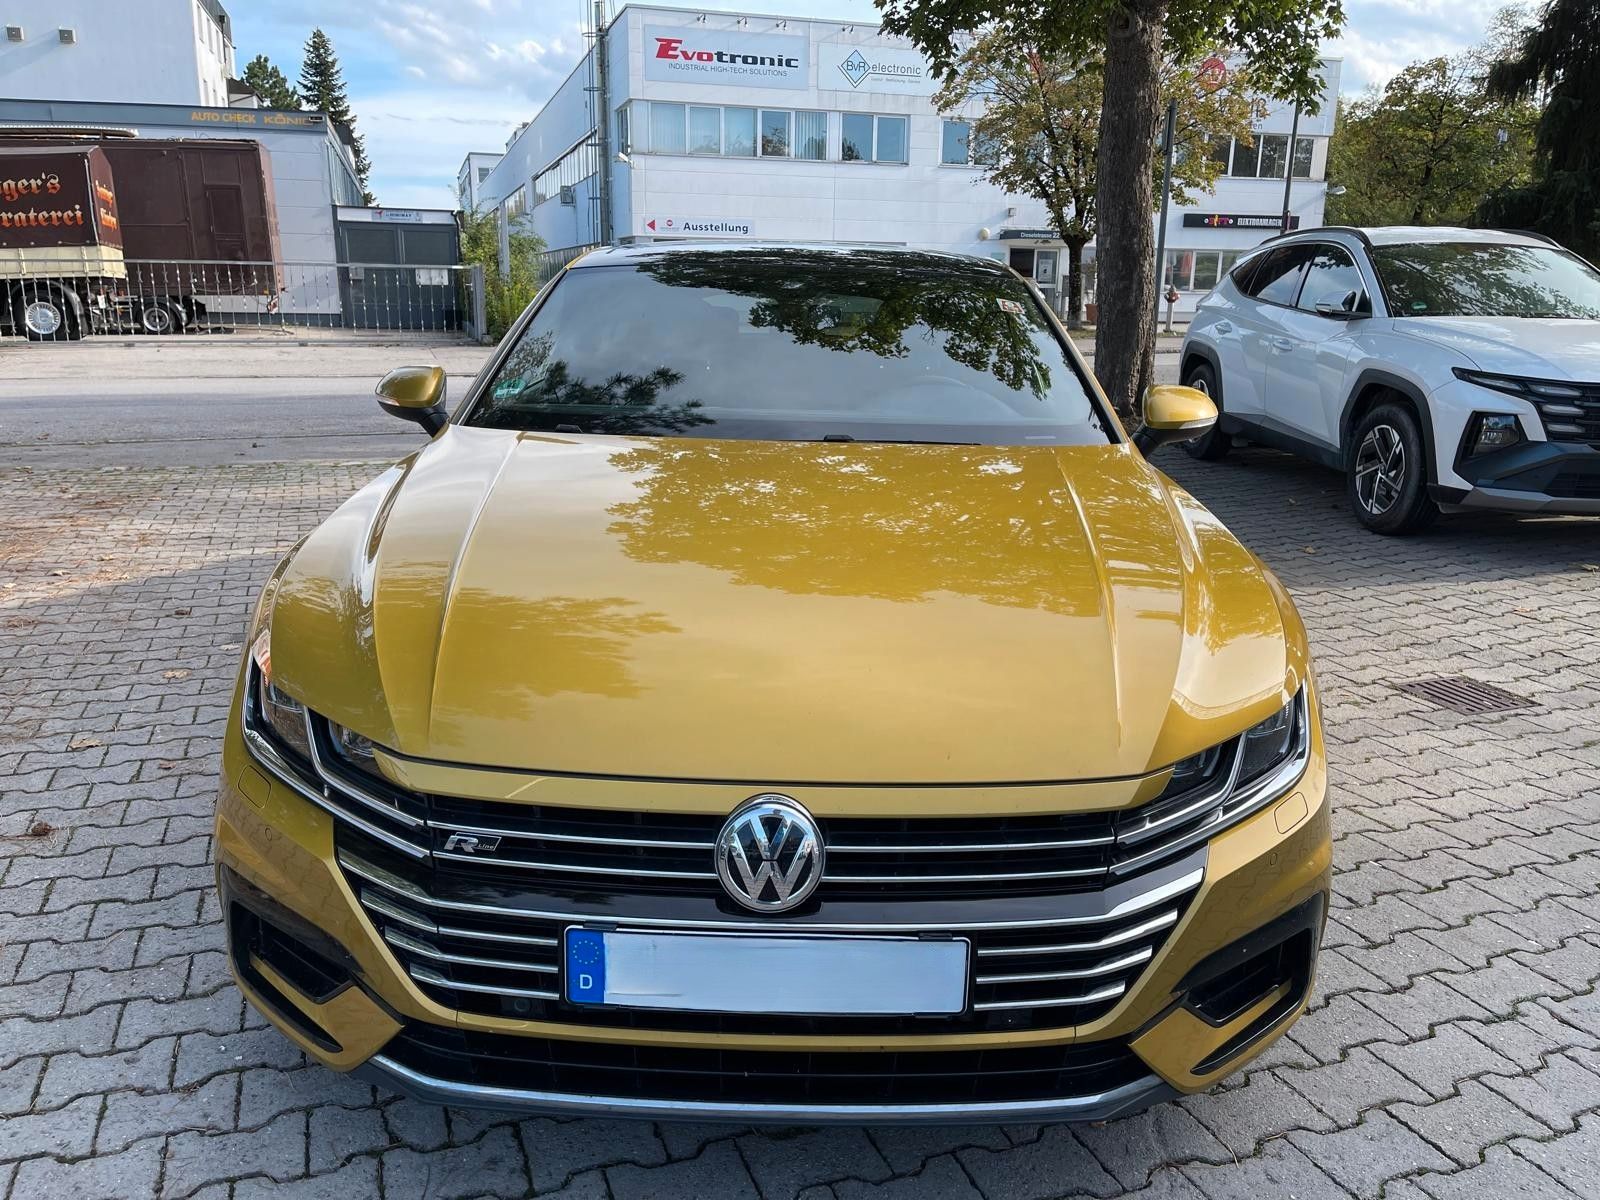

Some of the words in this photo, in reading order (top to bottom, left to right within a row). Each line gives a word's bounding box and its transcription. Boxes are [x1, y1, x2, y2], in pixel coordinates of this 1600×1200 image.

[655, 37, 799, 68] Evotronic
[668, 63, 709, 72] INDUSTRIAL
[710, 65, 748, 75] HIGH-TECH
[749, 68, 788, 77] SOLUTIONS
[846, 60, 866, 71] BvR
[871, 63, 921, 75] electronic
[191, 112, 220, 121] AUTO
[222, 113, 256, 124] CHECK
[0, 172, 61, 201] ger's
[683, 222, 749, 234] Ausstellung
[579, 973, 593, 990] D
